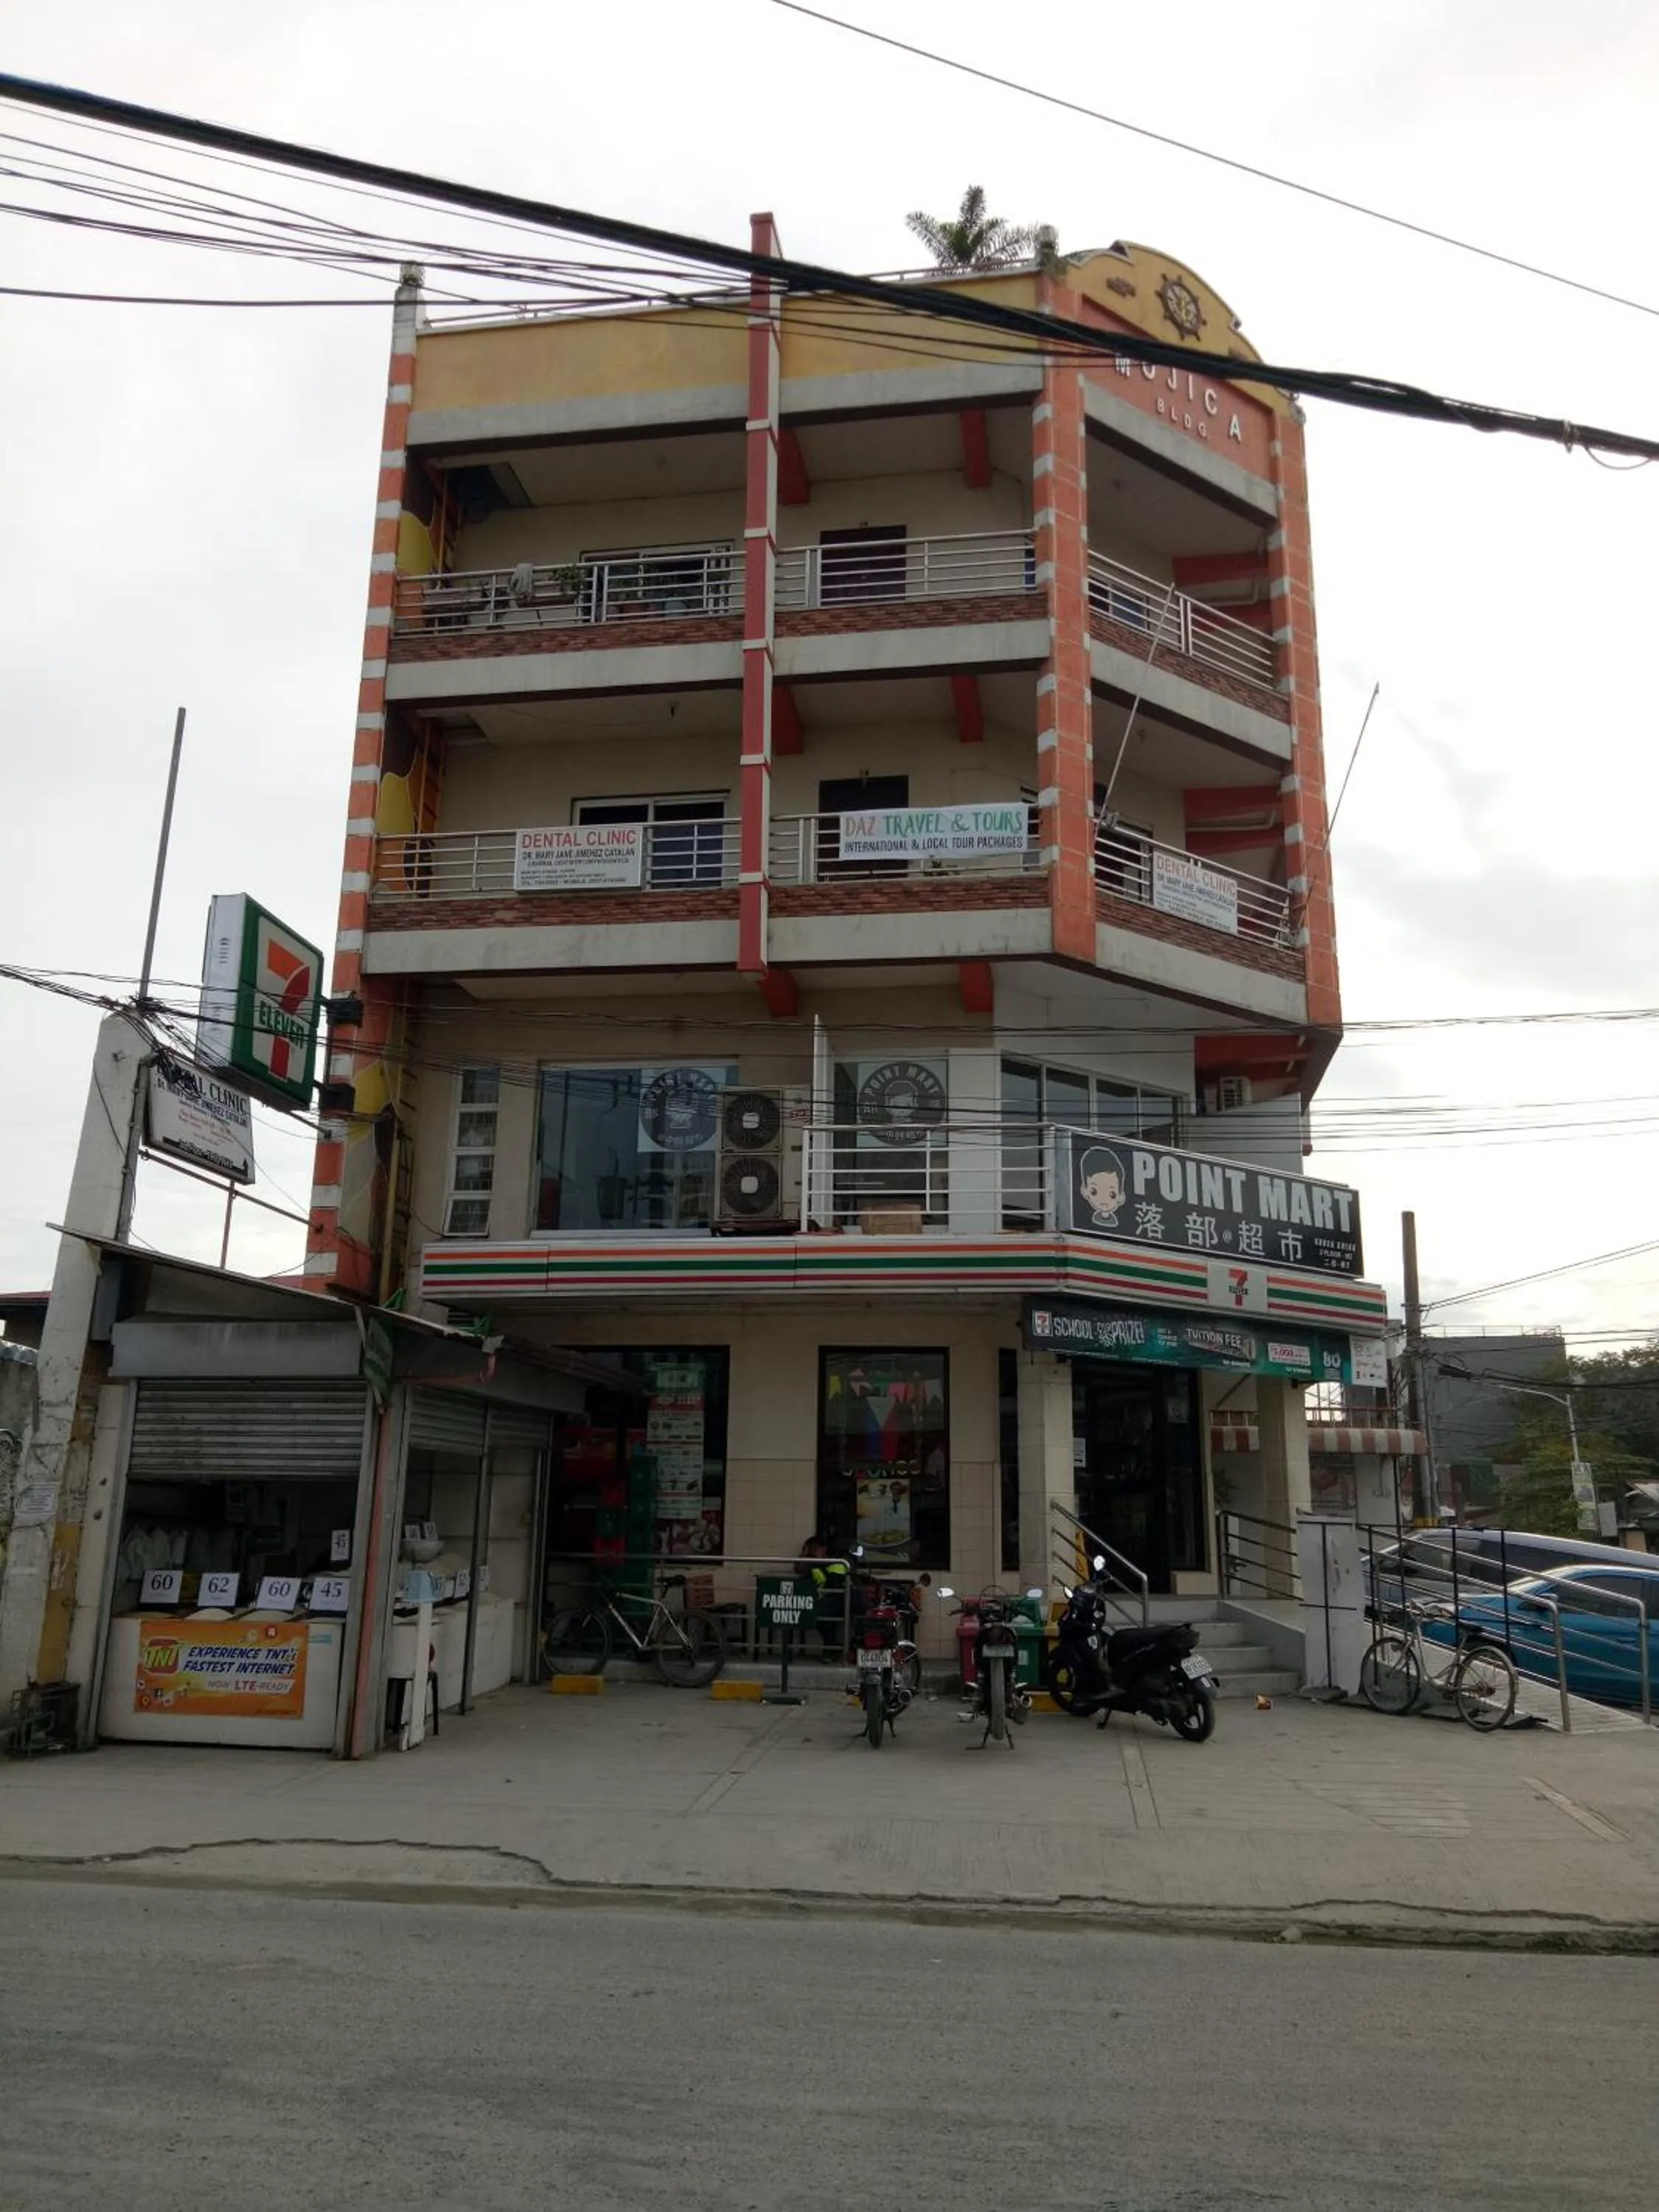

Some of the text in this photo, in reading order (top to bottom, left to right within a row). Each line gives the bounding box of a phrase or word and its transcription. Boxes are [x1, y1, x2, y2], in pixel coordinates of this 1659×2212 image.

[883, 813, 944, 838] TRAVEL
[951, 813, 970, 832] &
[973, 810, 1023, 834] TOURS
[522, 830, 636, 848] DENTAL CLINIC
[845, 841, 908, 853] INTERNATIONAL
[922, 838, 947, 849] LOCAL
[952, 836, 974, 849] TOUR
[977, 835, 1023, 849] PACKAGES
[1157, 856, 1200, 883] DENTAL
[1203, 872, 1237, 897] CLINIC
[210, 1082, 247, 1115] CLINIC
[1133, 1151, 1352, 1233] POINT MART
[1054, 1317, 1095, 1340] SCHOOL
[1186, 1328, 1223, 1345] TUITION
[1225, 1334, 1242, 1349] FEE
[151, 1574, 173, 1590] 60
[208, 1577, 229, 1593] 62
[268, 1581, 291, 1598] 60
[321, 1582, 343, 1599] 45
[762, 1594, 813, 1610] PARKING
[772, 1609, 801, 1624] ONLY
[144, 1645, 179, 1671] TNT
[189, 1647, 260, 1659] EXPERIENCE
[184, 1660, 295, 1675] FASTEST INTERNET
